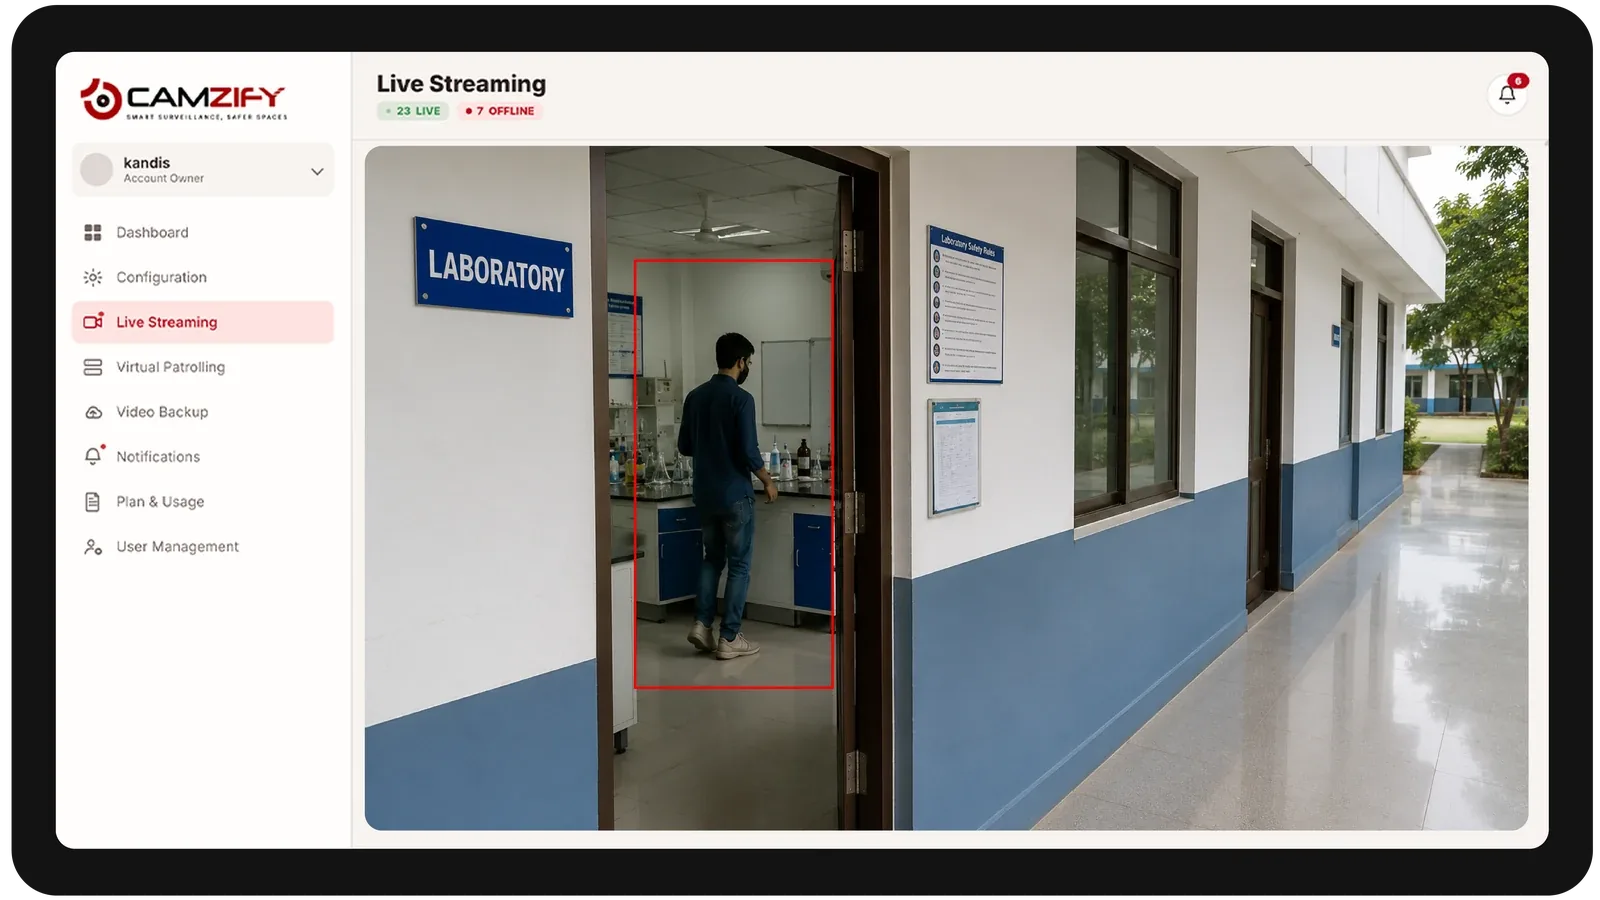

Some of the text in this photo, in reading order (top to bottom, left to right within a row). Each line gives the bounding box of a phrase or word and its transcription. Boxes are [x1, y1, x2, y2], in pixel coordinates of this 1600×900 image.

[378, 74, 545, 97] Live Streaming
[1515, 77, 1522, 85] 6
[128, 87, 284, 107] CAMZIFY
[397, 107, 440, 116] 23 LIVE
[477, 106, 534, 116] 7 OFFLINE
[124, 157, 170, 168] kandis
[124, 174, 204, 183] Account Owner
[117, 227, 188, 238] Dashboard
[941, 234, 967, 252] Laboratory
[968, 241, 983, 255] Safety
[428, 248, 566, 293] LABORATORY
[117, 271, 206, 286] Configuration
[117, 316, 217, 330] Live Streaming
[117, 361, 225, 376] Virtual Patrolling
[117, 406, 208, 420] Video Backup
[118, 451, 200, 462] Notifications
[118, 496, 204, 510] Plan & Usage
[117, 541, 239, 555] User Management
